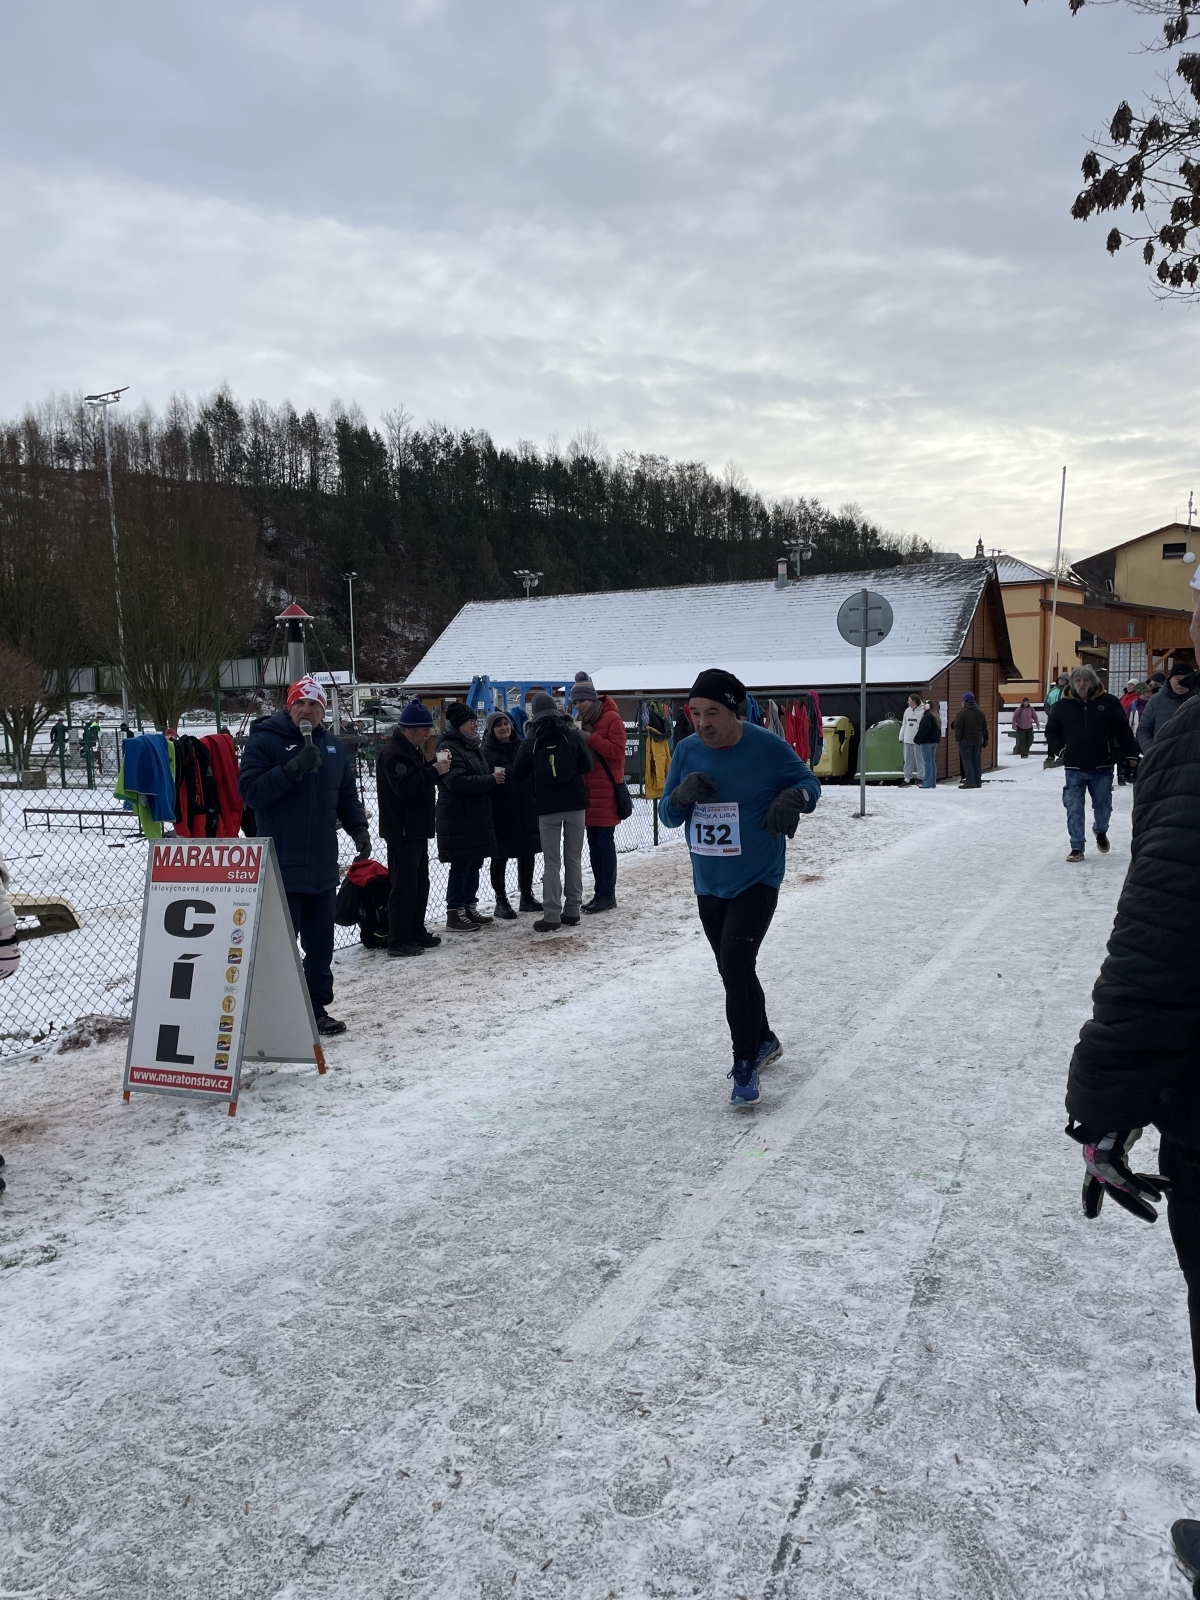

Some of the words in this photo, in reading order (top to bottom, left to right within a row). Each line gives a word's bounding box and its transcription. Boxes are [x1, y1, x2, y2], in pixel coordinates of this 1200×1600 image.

[695, 823, 733, 846] 132
[153, 846, 262, 868] MARATON
[227, 869, 256, 880] stav
[202, 885, 232, 894] jednota
[235, 884, 258, 894] Úpice
[133, 1070, 229, 1089] www.maratonstav.cz
